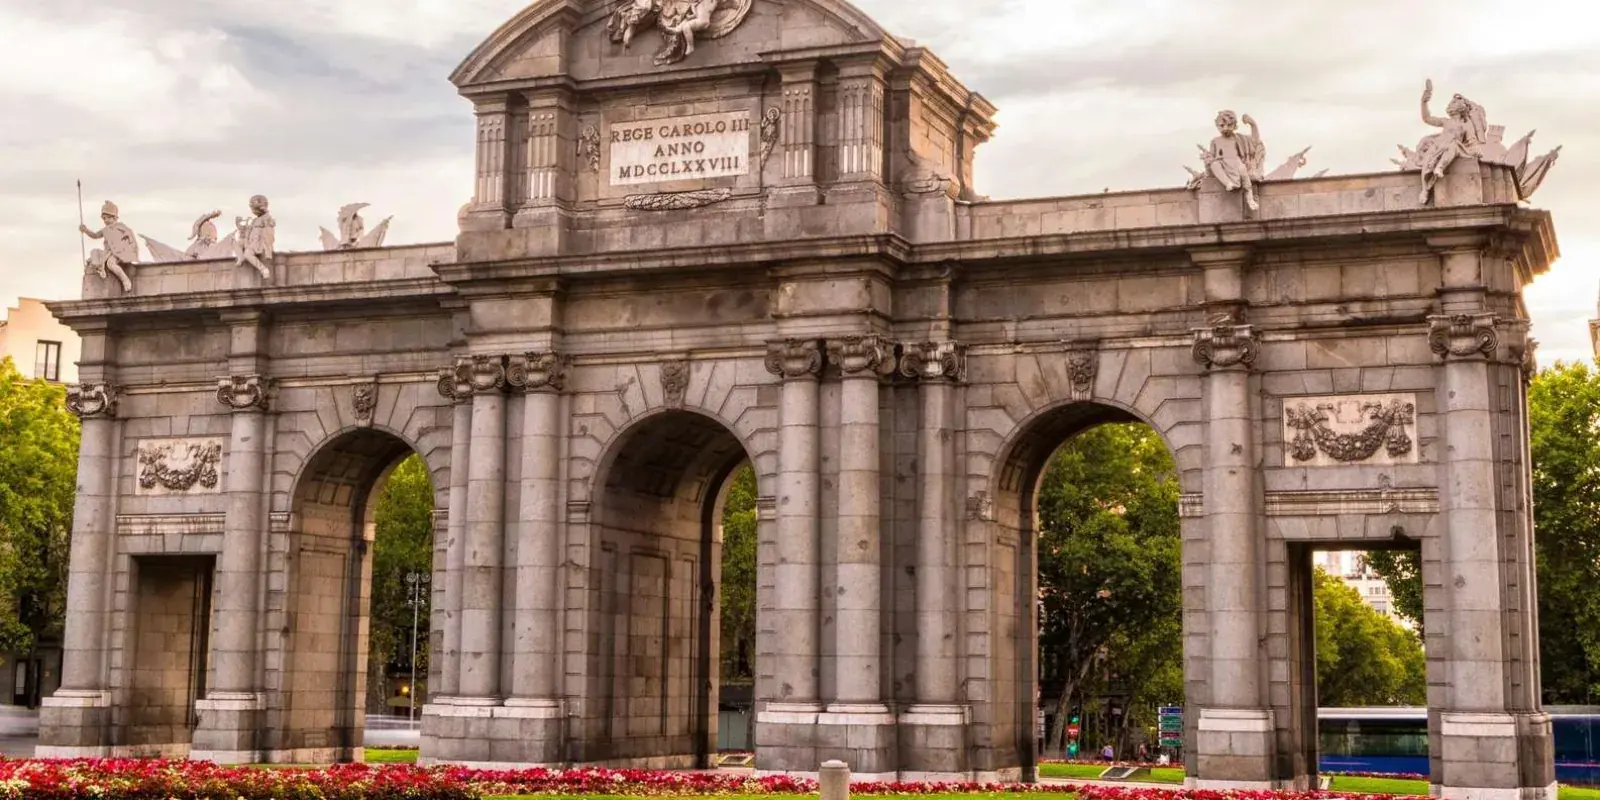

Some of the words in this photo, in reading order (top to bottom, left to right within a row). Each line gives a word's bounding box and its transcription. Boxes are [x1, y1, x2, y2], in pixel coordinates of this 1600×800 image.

[611, 127, 653, 143] REGE
[659, 121, 726, 138] CAROLO
[731, 118, 750, 132] III
[654, 141, 705, 157] ANNO
[619, 156, 739, 178] MDCCLXXVIII
